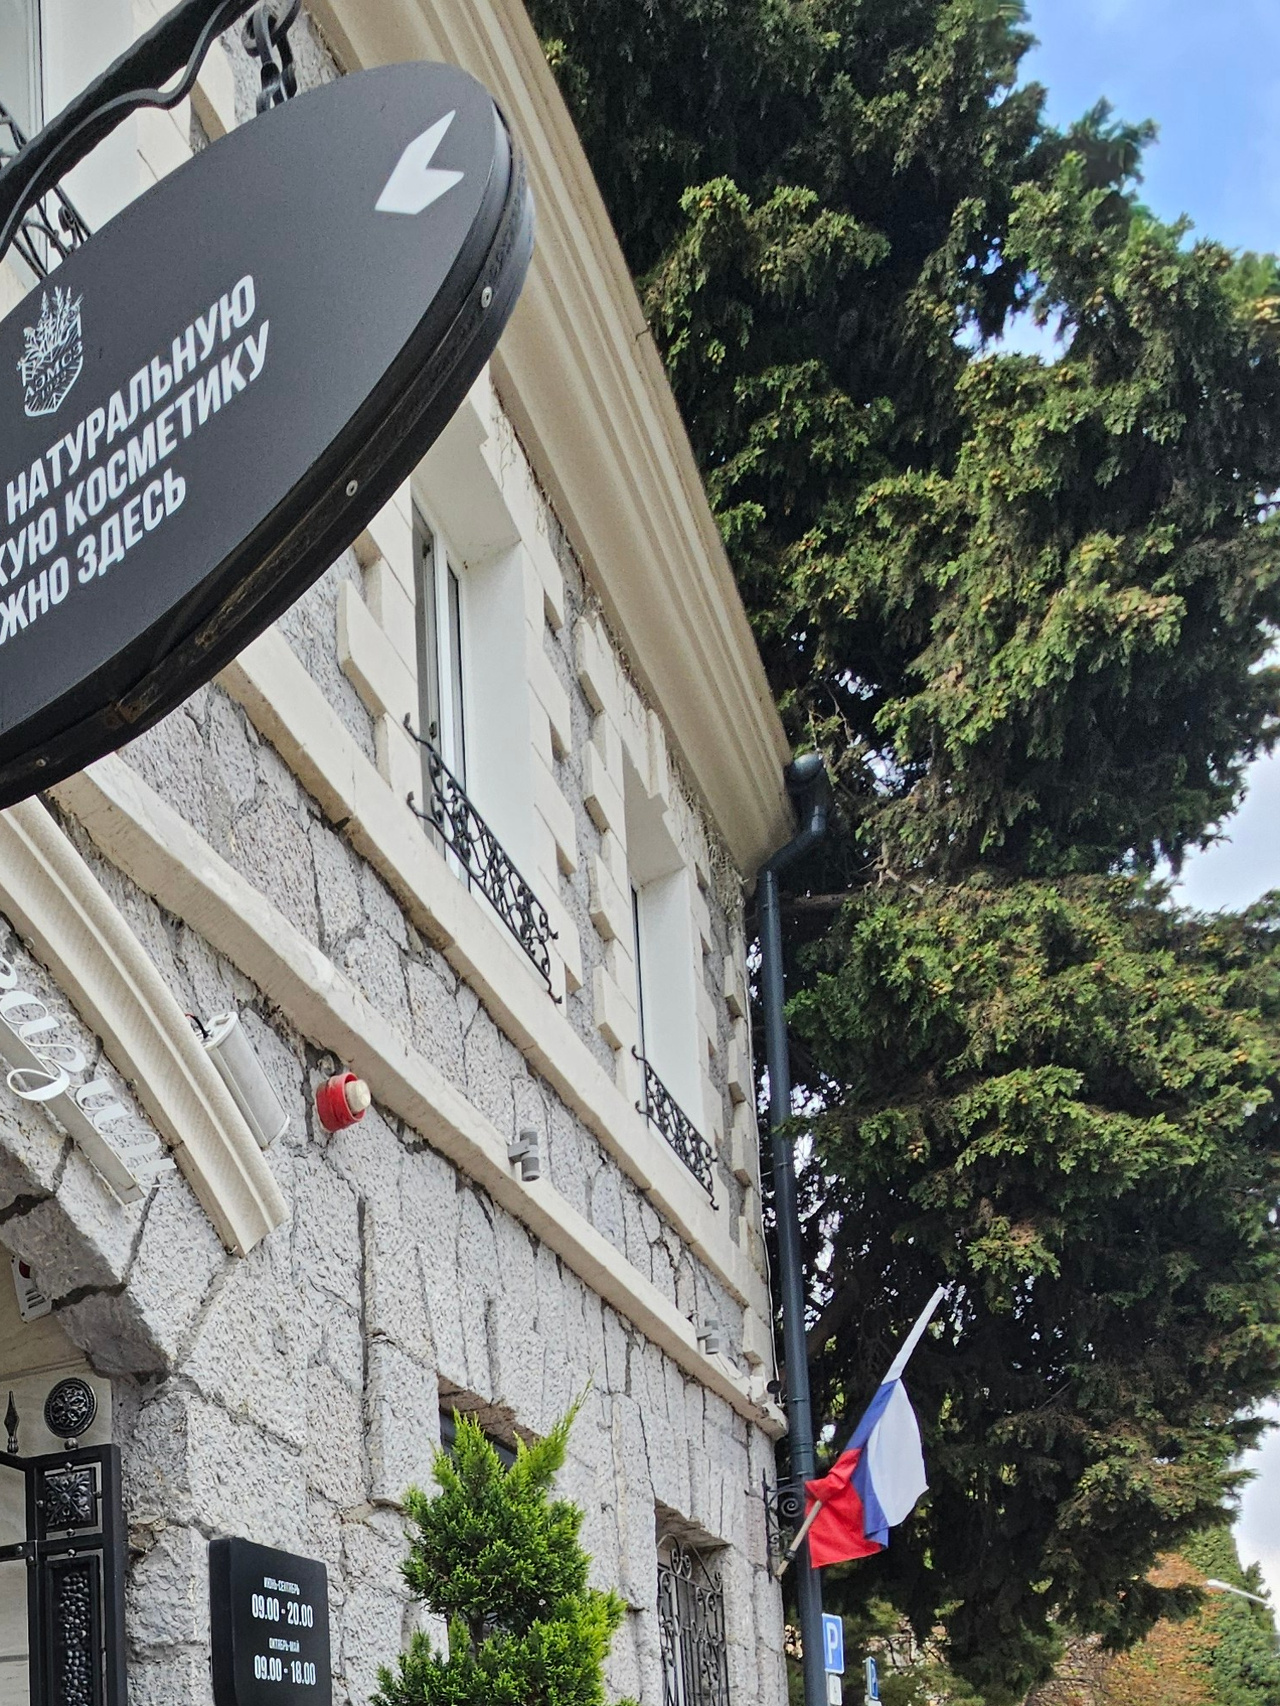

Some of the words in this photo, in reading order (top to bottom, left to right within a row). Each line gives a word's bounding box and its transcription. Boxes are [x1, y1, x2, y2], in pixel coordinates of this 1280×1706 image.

[6, 274, 256, 525] НАТУРАЛЬНУЮ
[25, 341, 83, 402] АЭМСЗ
[65, 319, 270, 536] КОСМЕТИКУ
[77, 468, 187, 584] ЗДЕСЬ
[252, 1594, 278, 1621] 09.00
[287, 1602, 312, 1627] 20.00
[254, 1655, 282, 1682] 09.00
[291, 1660, 316, 1686] 18.00
[826, 1622, 838, 1665] P
